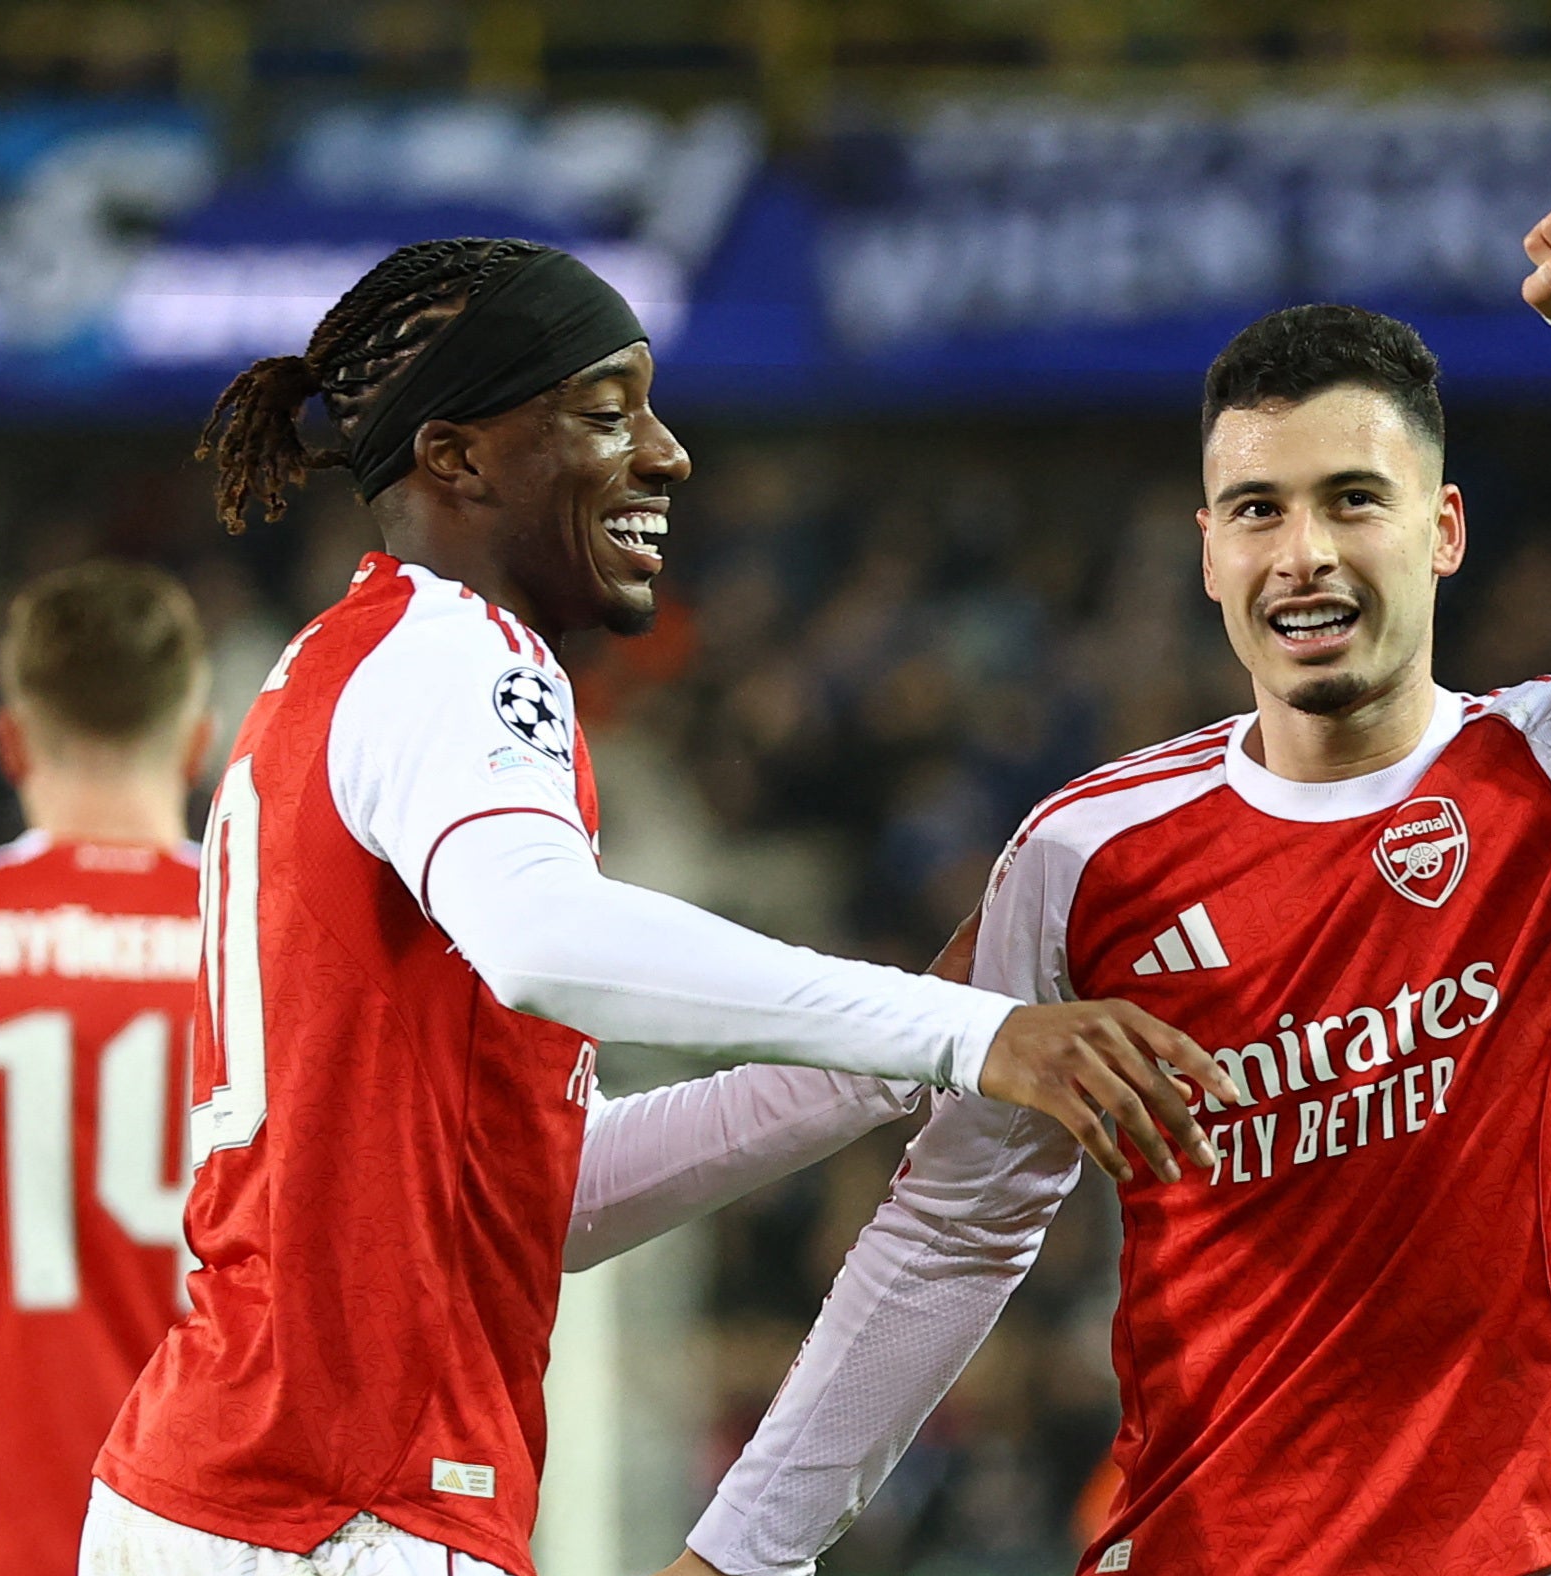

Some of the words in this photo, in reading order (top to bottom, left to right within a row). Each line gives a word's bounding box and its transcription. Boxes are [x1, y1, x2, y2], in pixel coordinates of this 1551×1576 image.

[1384, 812, 1450, 843] Arsenal
[1209, 1112, 1277, 1186] FLY
[1293, 1056, 1456, 1165] BETTER
